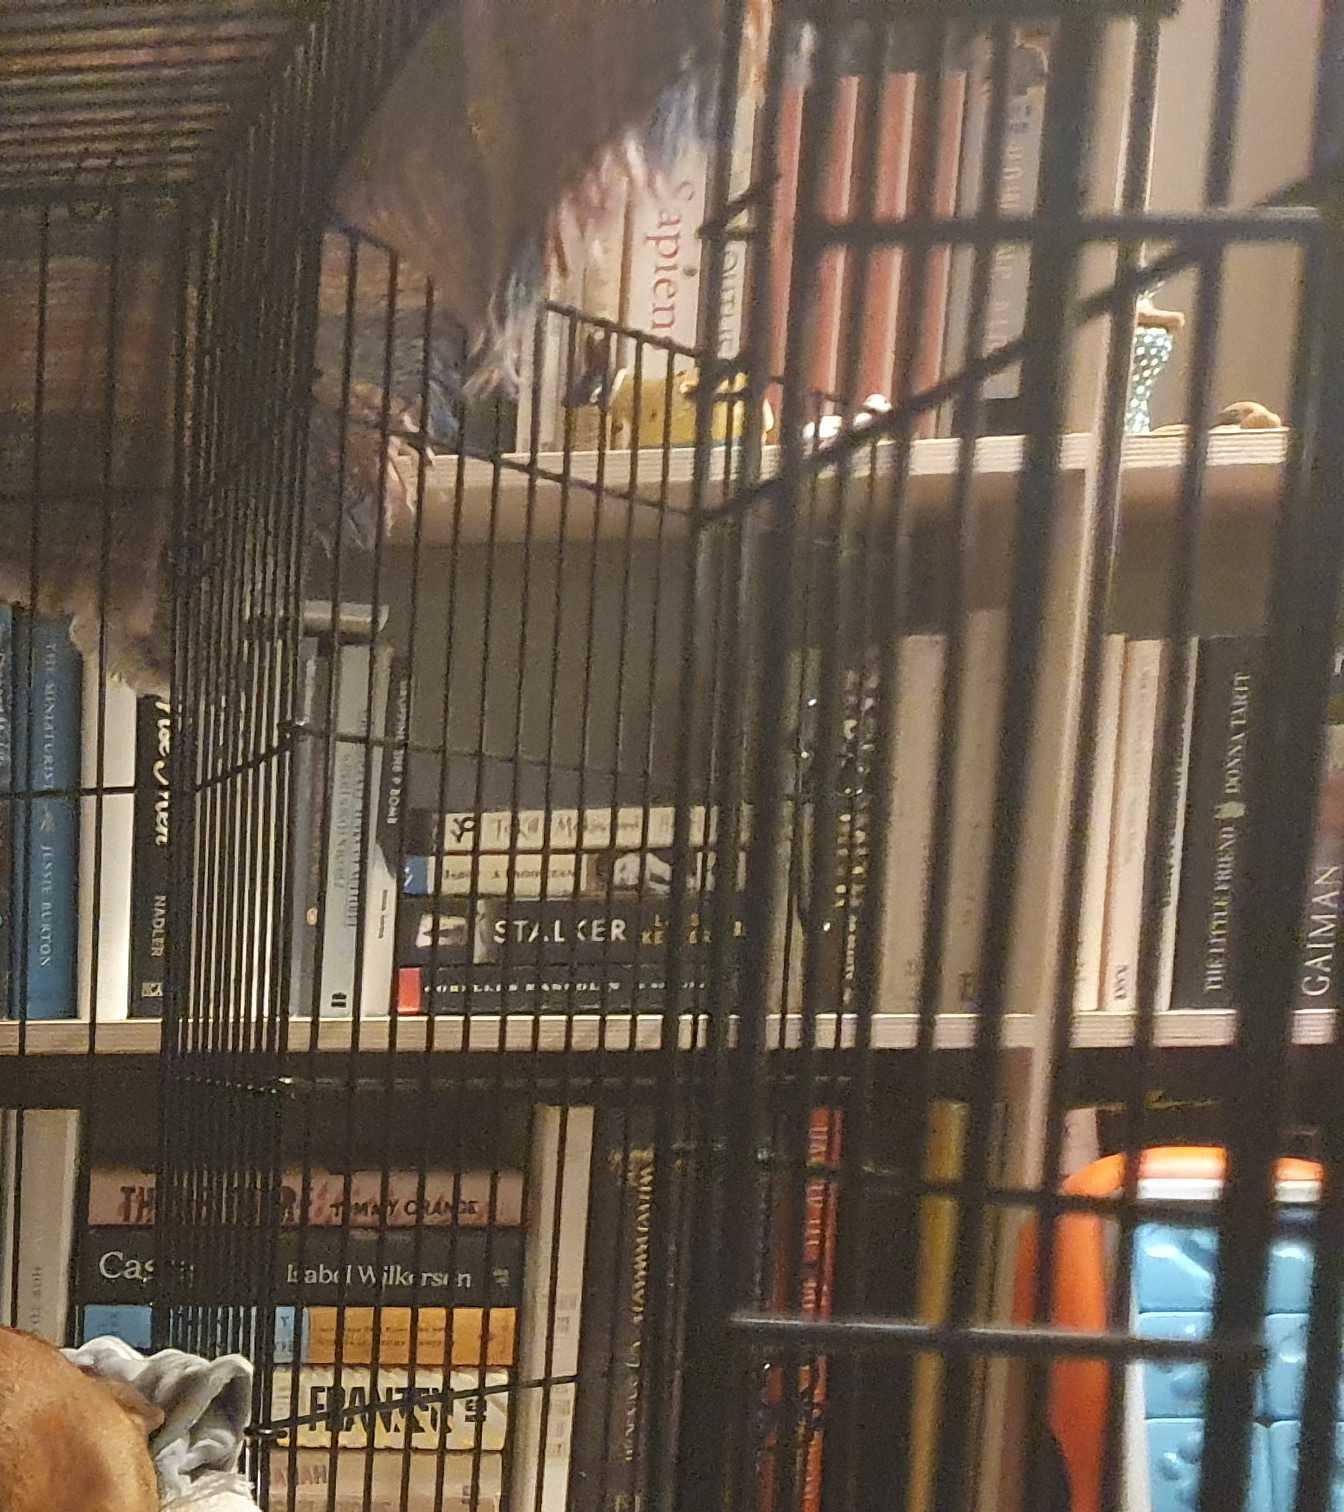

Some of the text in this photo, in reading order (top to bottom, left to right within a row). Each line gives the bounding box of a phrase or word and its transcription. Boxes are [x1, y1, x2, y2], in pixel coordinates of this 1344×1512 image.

[645, 181, 696, 330] Sapien
[1224, 733, 1245, 795] DONNA
[1214, 826, 1235, 891] FRIEND
[39, 844, 54, 967] JESSIE BURTON
[151, 895, 167, 957] NADLER
[1300, 866, 1342, 998] GAIMAN
[330, 1202, 400, 1217] TMMY
